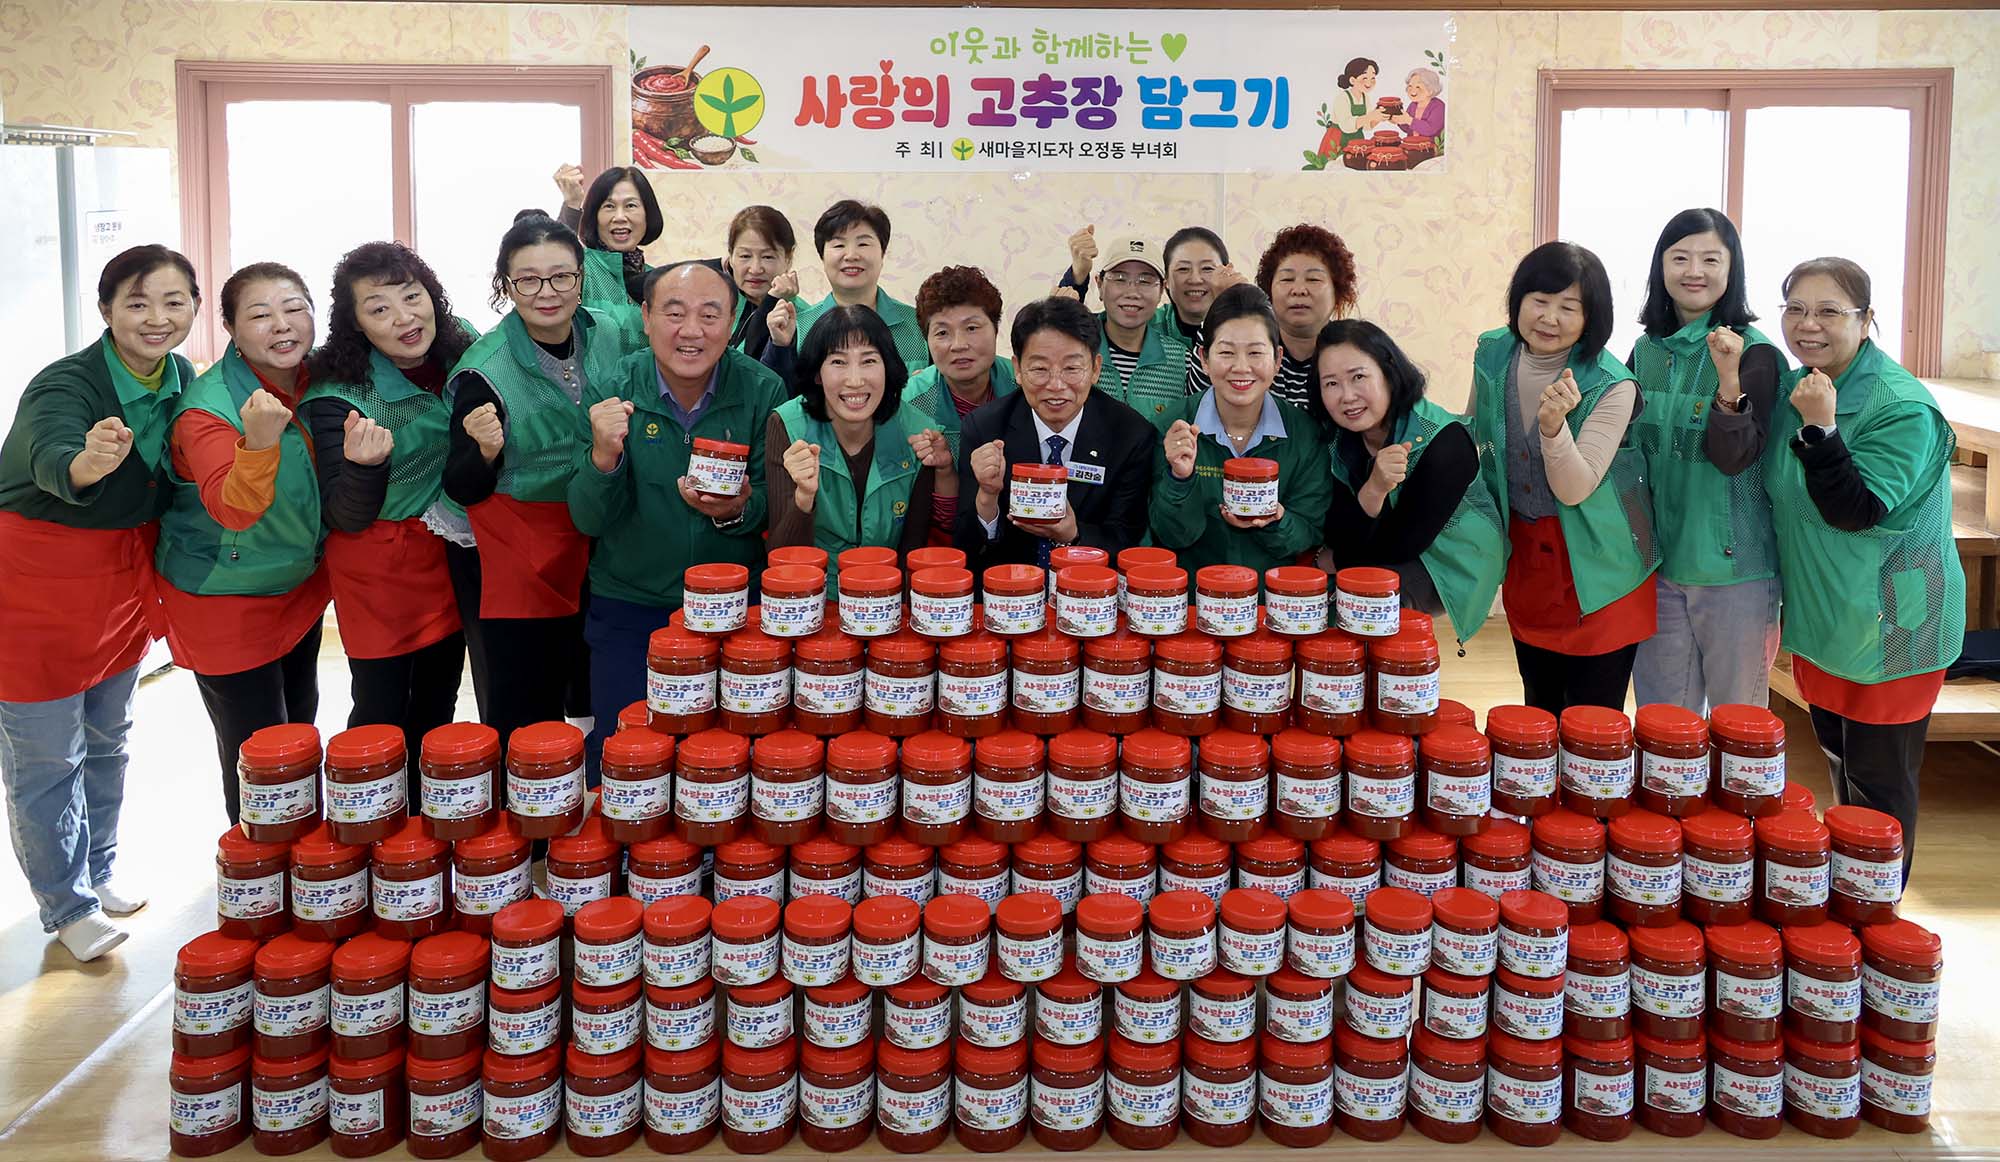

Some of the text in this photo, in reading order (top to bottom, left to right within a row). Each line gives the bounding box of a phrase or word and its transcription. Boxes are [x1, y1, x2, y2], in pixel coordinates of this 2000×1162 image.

[930, 27, 1153, 65] 이웃과 함께하는
[794, 72, 1289, 130] 사랑의 고추장 담그기
[896, 142, 911, 158] 주
[978, 141, 1074, 159] 새마을지도자
[1078, 141, 1126, 159] 오정동
[1130, 141, 1177, 159] 부녀회
[1030, 489, 1062, 498] 고추장
[784, 602, 819, 613] 고추장
[666, 683, 705, 692] 고추장
[746, 680, 782, 690] 고추장
[892, 684, 928, 693] 고추장
[1251, 682, 1285, 691] 고추장
[349, 787, 392, 799] 고추장
[432, 784, 475, 797] 고추장
[533, 784, 575, 795] 고추장
[615, 788, 657, 798] 고추장
[1146, 789, 1181, 799] 고추장
[254, 790, 299, 801] 고추장
[481, 875, 521, 891] 고추장
[221, 885, 264, 896] 고추장
[309, 885, 352, 896] 고추장
[383, 886, 426, 896] 고추장
[877, 945, 914, 959] 고추장
[1170, 945, 1208, 954] 고추장
[502, 953, 544, 965] 고추장
[1663, 982, 1700, 993] 고추장
[205, 991, 250, 1010] 고추장
[346, 1000, 385, 1012] 고추장
[426, 998, 470, 1011] 고추장
[269, 1000, 313, 1013] 고추장
[738, 1014, 779, 1025] 고추장
[275, 1087, 321, 1108] 고추장
[597, 1093, 636, 1109] 고추장
[681, 1092, 717, 1107] 고추장
[177, 1099, 220, 1111] 고추장
